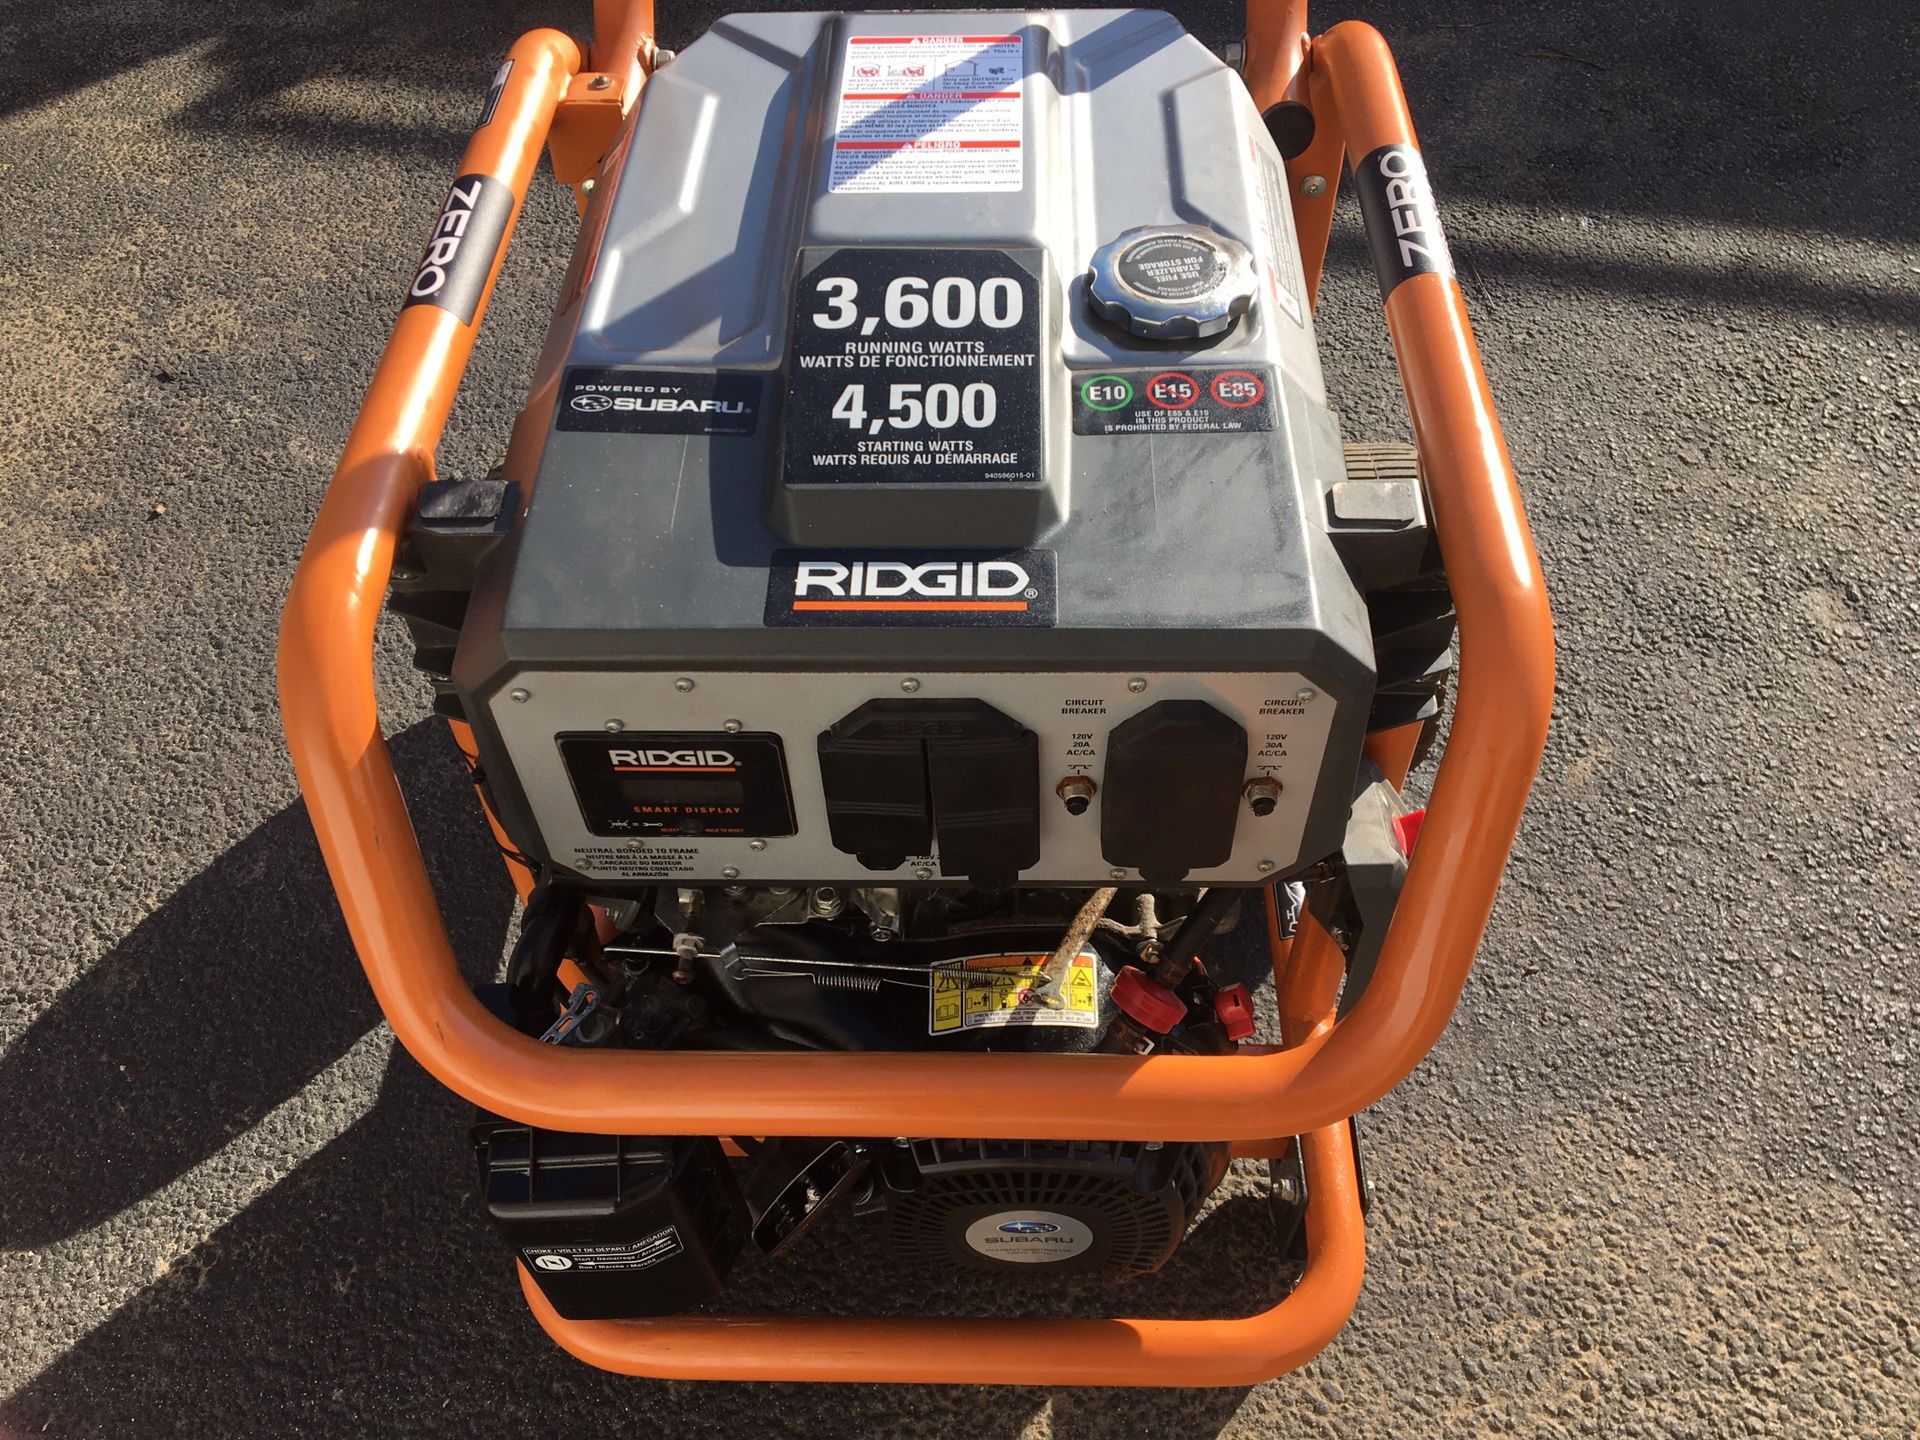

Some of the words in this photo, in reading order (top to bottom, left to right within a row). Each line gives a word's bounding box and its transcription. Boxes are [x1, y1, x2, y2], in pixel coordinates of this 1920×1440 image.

[913, 141, 961, 149] PELIGRO
[1379, 151, 1456, 276] ZERO
[411, 180, 482, 297] ZERO
[1137, 258, 1182, 271] STORAGE
[1183, 255, 1203, 264] FOR
[1146, 263, 1201, 277] STABILIZER
[1180, 271, 1199, 280] USE
[1153, 274, 1179, 283] FUEL
[812, 276, 1023, 336] 3,600
[845, 342, 923, 354] RUNNING
[928, 341, 985, 354] WATTS
[800, 355, 854, 368] WATTS
[859, 355, 881, 367] DE
[886, 354, 1035, 367] FONCTIONNEMENT
[575, 385, 655, 393] POWERED
[1089, 386, 1126, 401] E10
[1154, 383, 1192, 399] E15
[1219, 382, 1257, 398] E85
[613, 397, 745, 414] SUBARU
[832, 383, 997, 435] 4,500
[1168, 416, 1209, 424] PRODUCT
[1104, 424, 1113, 433] IS
[1115, 424, 1167, 432] PROHIBITED
[1169, 423, 1180, 431] BY
[1182, 422, 1221, 430] FEDERAL
[857, 440, 924, 452] STARTING
[928, 440, 974, 452] WATTS
[813, 454, 857, 465] WATTS
[860, 454, 910, 465] REQUIS
[913, 454, 932, 465] AU
[936, 452, 1018, 464] DÉMARRAGE
[632, 806, 679, 814] SMART
[685, 806, 741, 814] DISPLAY
